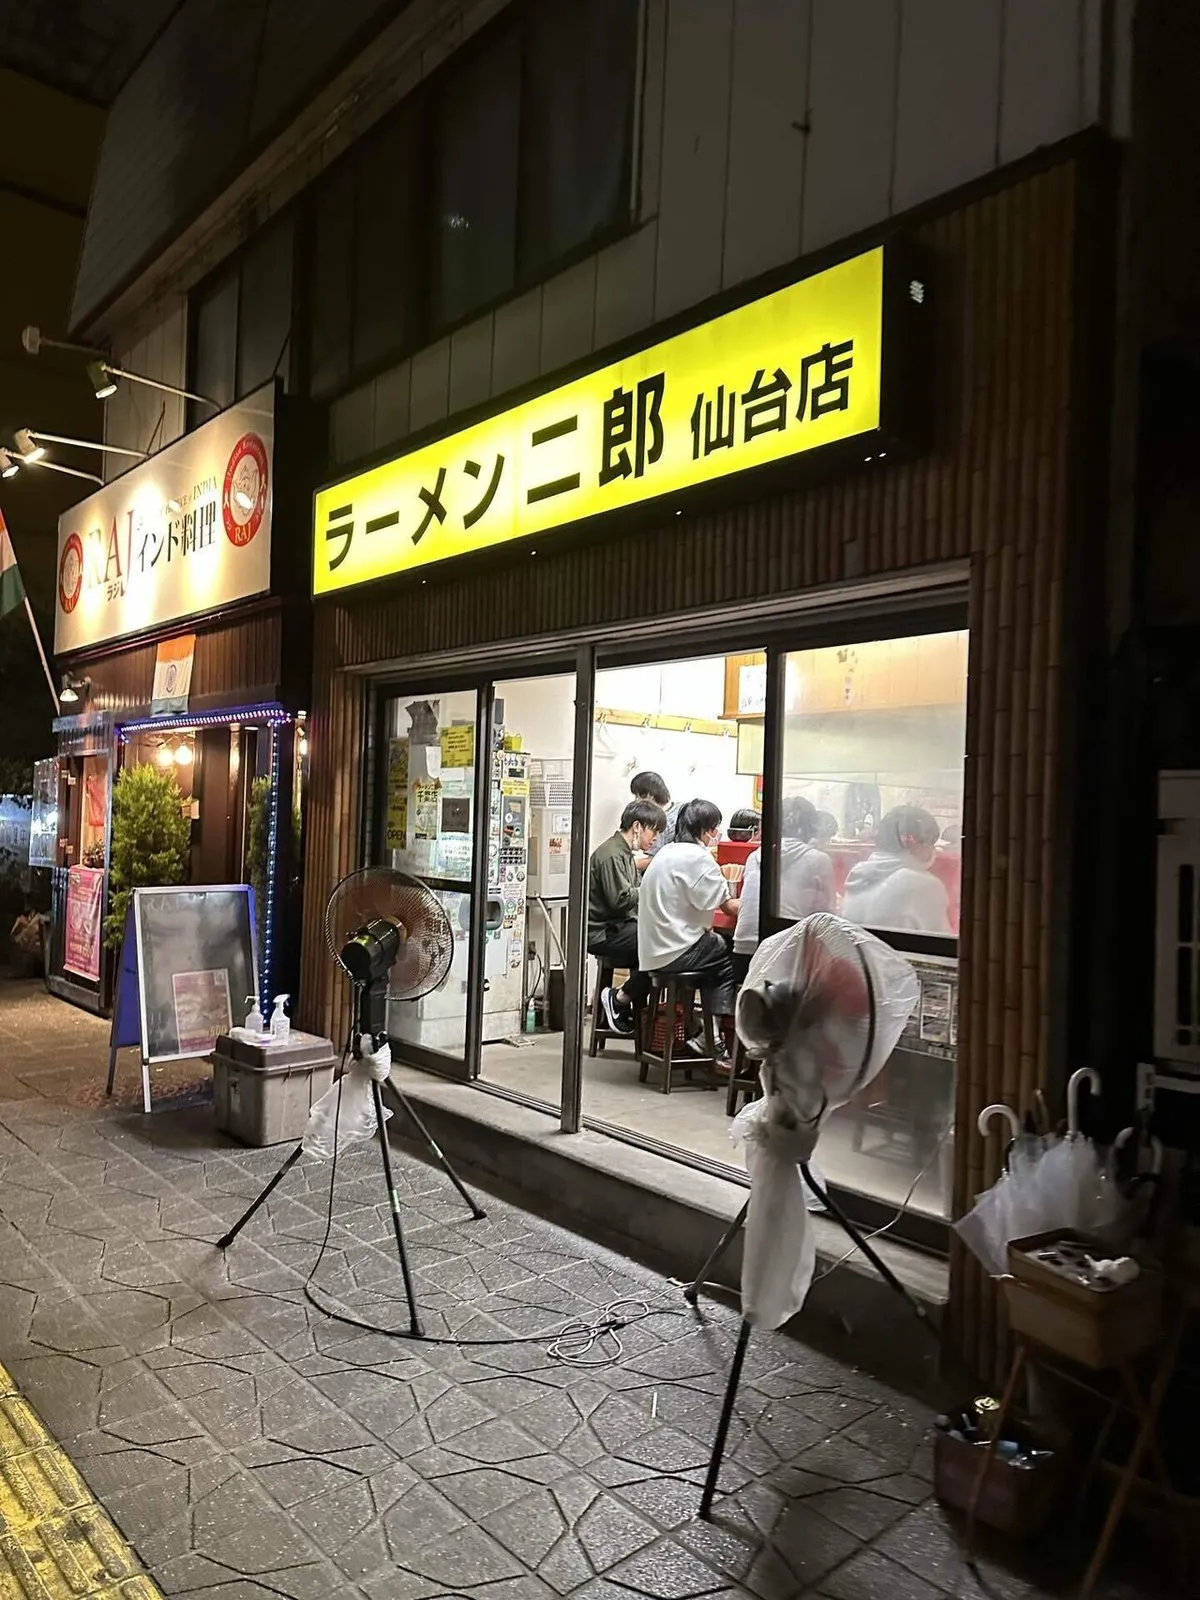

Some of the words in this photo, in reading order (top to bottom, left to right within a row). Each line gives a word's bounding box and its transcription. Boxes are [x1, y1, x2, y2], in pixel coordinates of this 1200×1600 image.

[325, 371, 665, 571] ラーメン二郎
[690, 339, 854, 460] 仙台店
